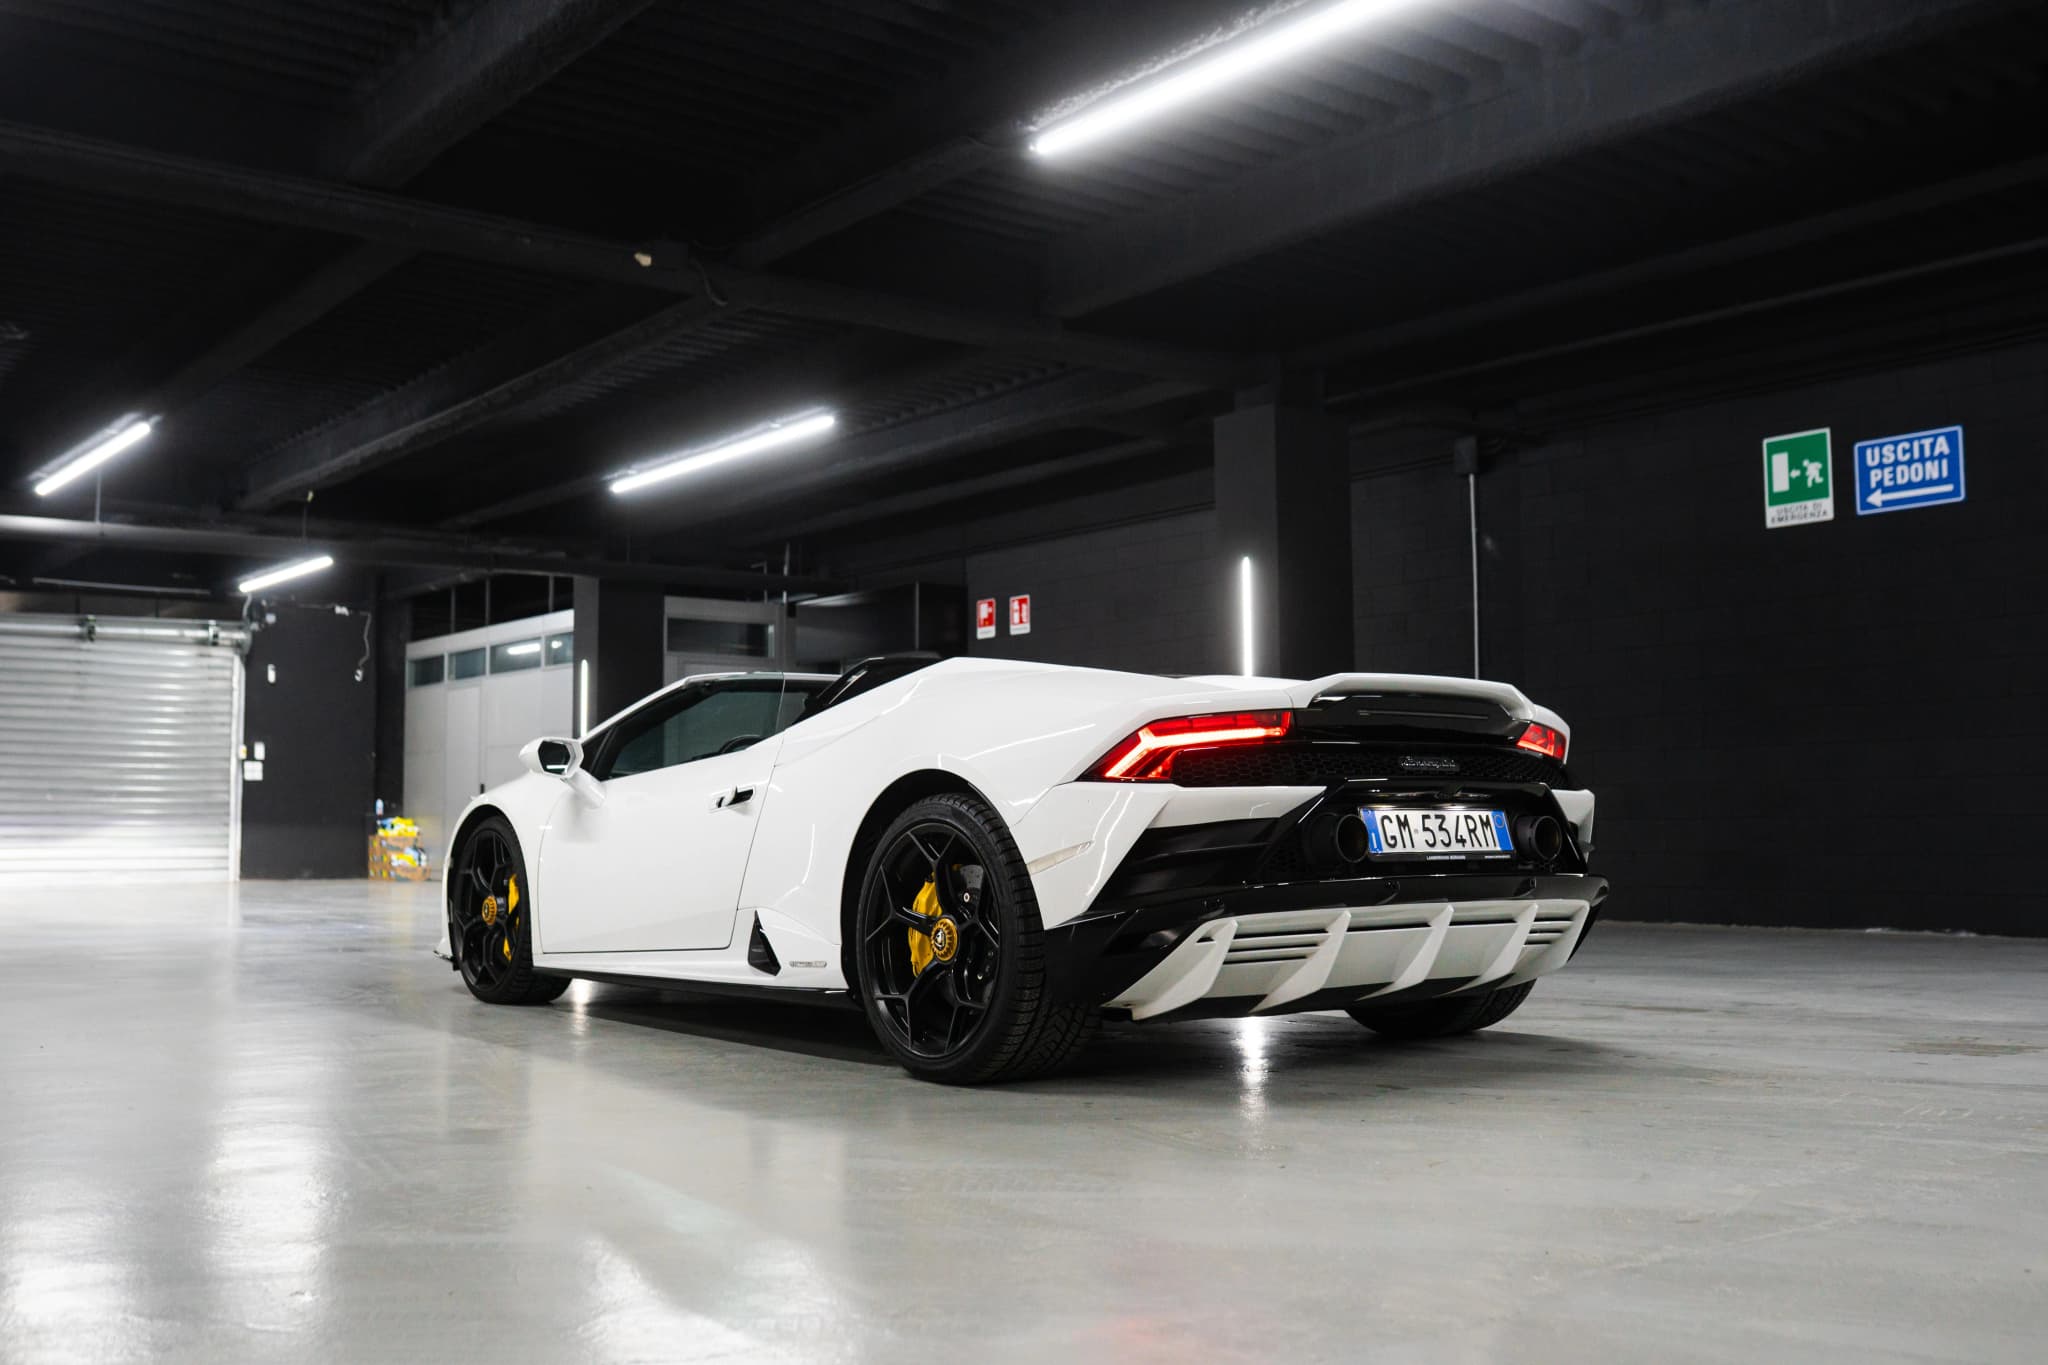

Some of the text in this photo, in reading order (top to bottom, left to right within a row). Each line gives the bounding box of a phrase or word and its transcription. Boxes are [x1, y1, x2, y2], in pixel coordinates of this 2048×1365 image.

[1866, 435, 1950, 467] USCITA
[1870, 458, 1948, 489] PEDONI
[1380, 814, 1497, 849] GM 534RM
